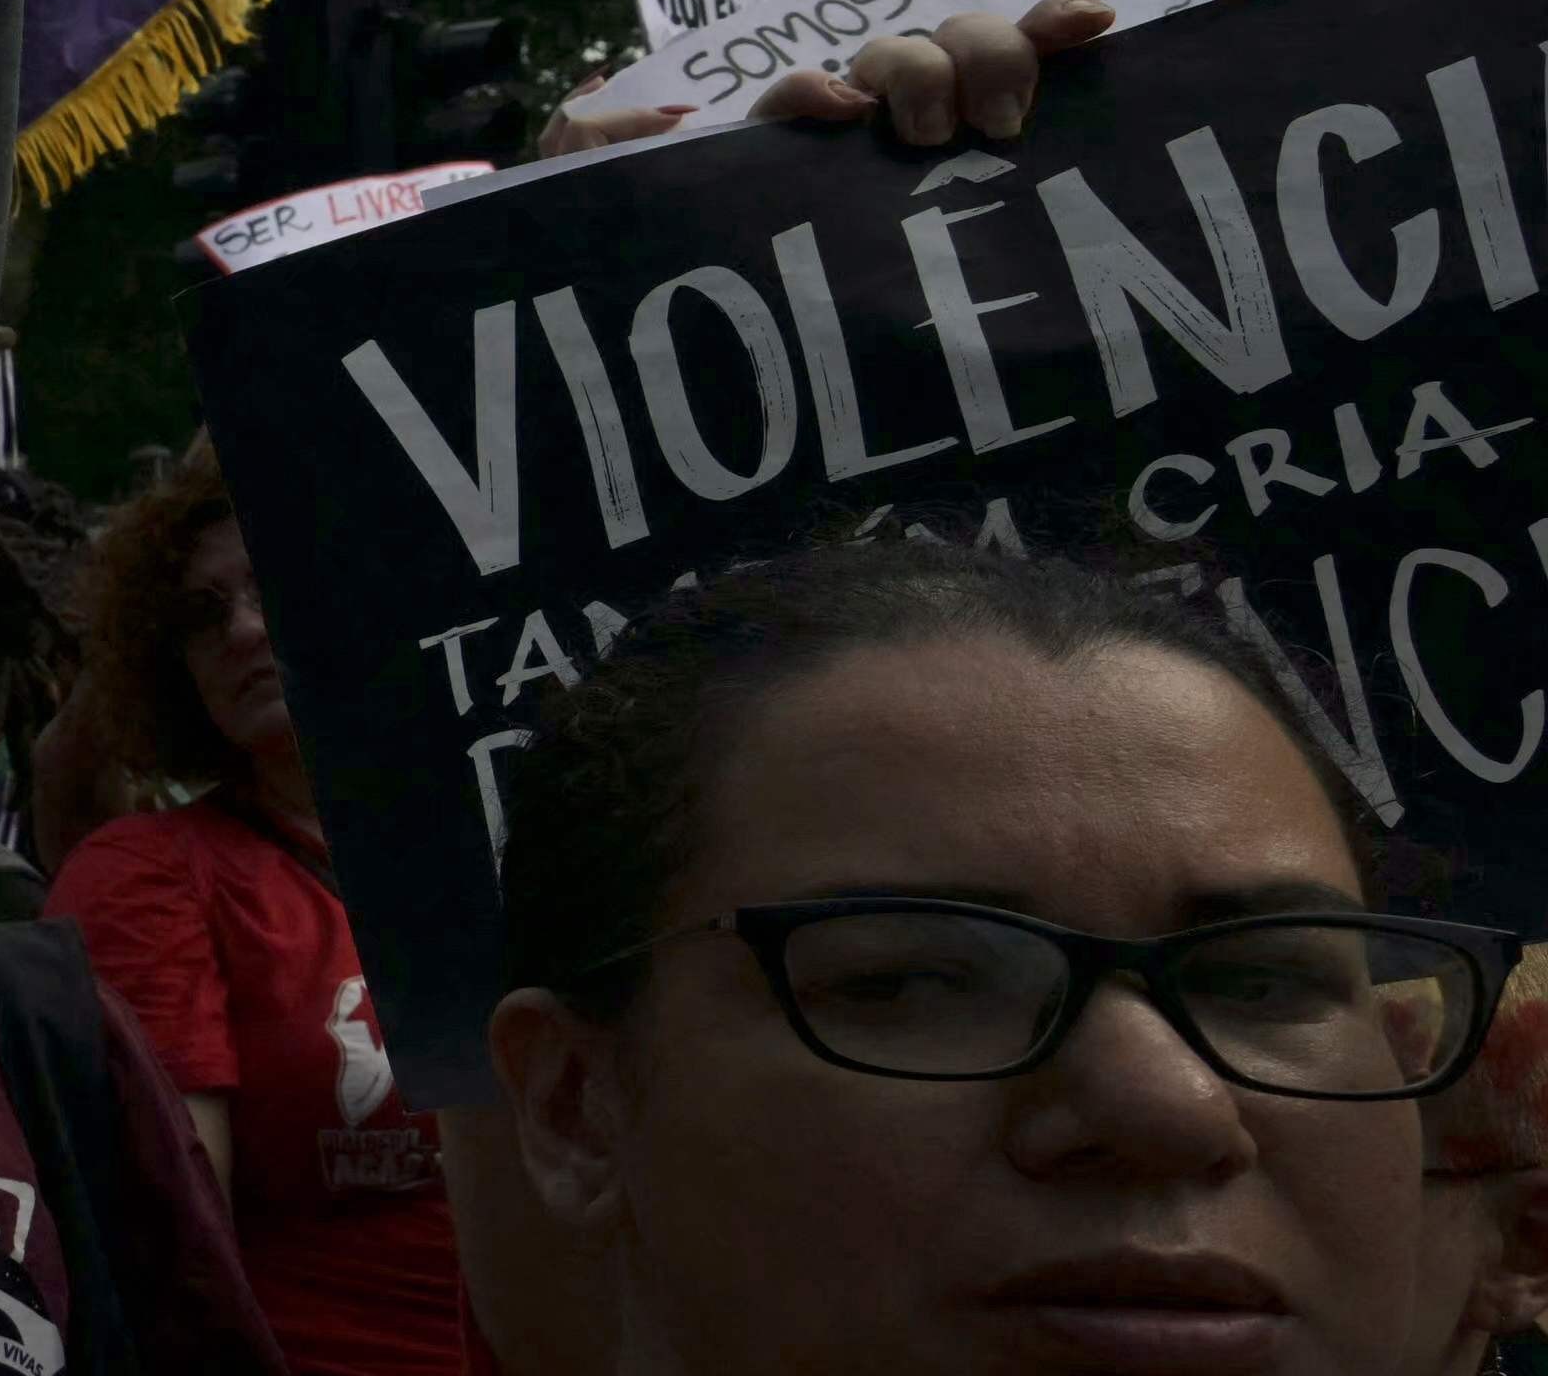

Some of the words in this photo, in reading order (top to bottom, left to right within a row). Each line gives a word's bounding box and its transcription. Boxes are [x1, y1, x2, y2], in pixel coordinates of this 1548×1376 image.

[214, 205, 313, 255] SER
[341, 49, 1548, 575] VIOLÊNCI
[1126, 380, 1536, 541] CRIA
